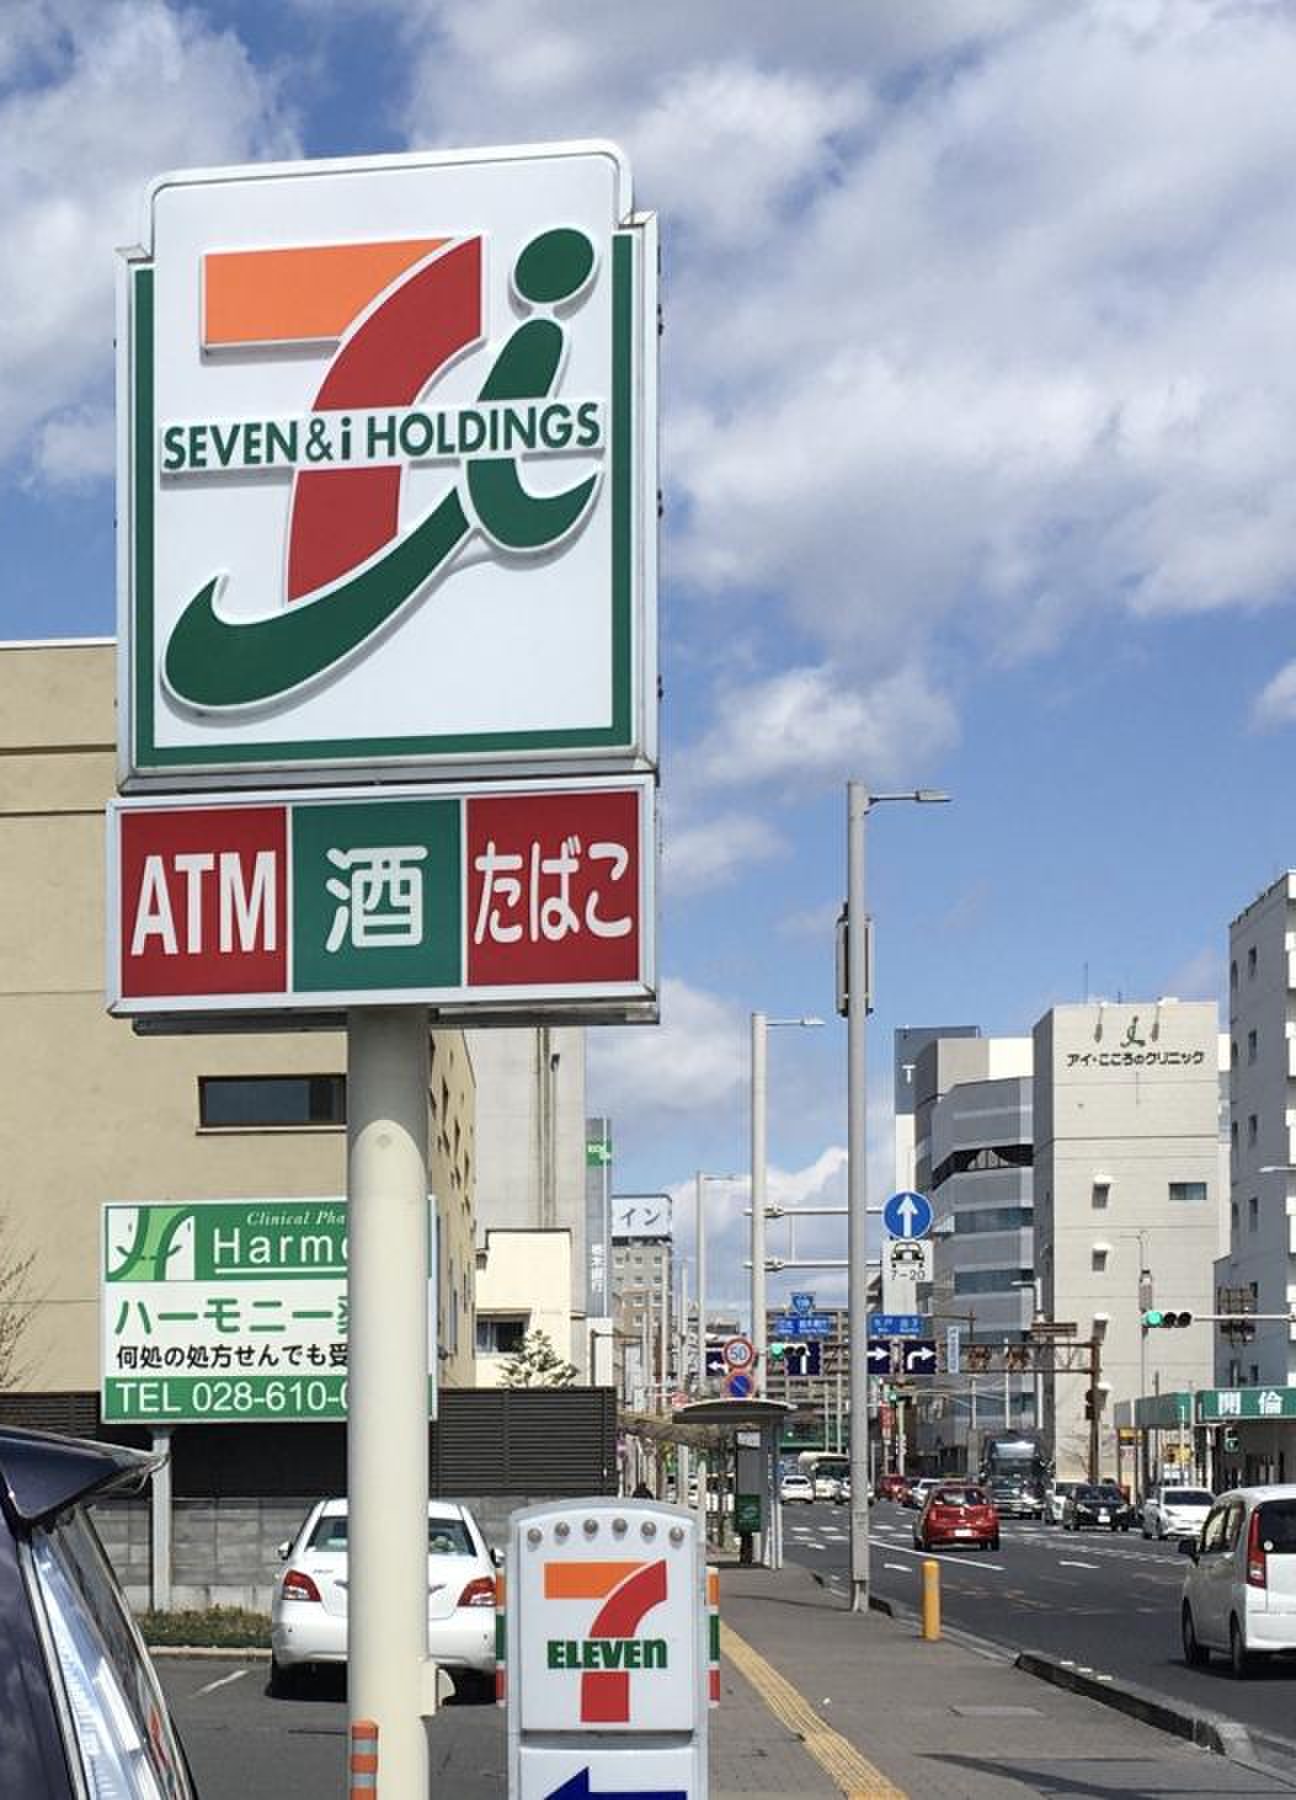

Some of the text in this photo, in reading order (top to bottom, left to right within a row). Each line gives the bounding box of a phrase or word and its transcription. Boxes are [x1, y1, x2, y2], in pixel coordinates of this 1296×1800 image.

[365, 402, 600, 459] HOLDINGS
[130, 850, 278, 957] ATM
[325, 845, 429, 953] 酒
[474, 835, 633, 945] たばこ
[246, 1210, 309, 1226] Clinical
[213, 1227, 348, 1264] Harm
[730, 1344, 748, 1361] 50
[115, 1382, 182, 1413] TEL
